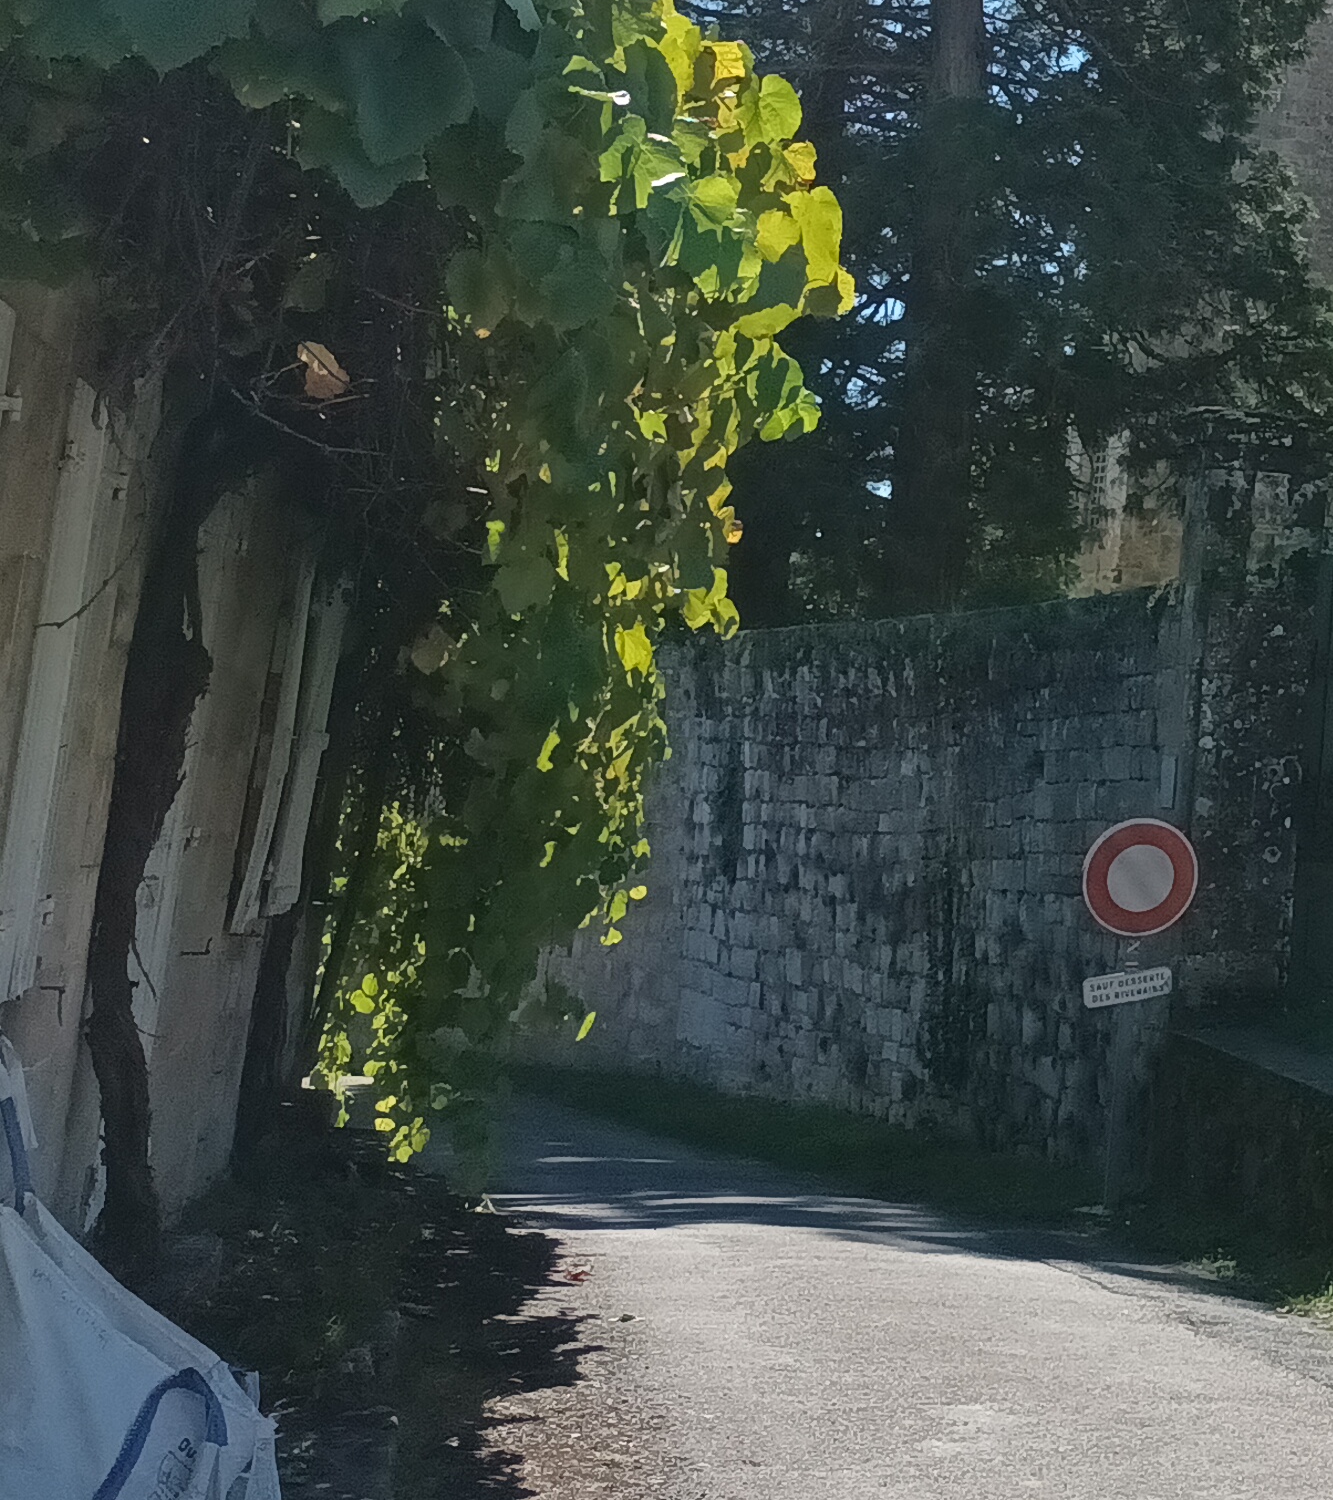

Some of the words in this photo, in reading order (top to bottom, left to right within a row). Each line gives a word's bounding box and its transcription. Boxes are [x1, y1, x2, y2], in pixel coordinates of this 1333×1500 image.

[1089, 980, 1115, 993] SAUF
[1118, 971, 1165, 988] DESSERTE
[1092, 992, 1111, 1004] DES
